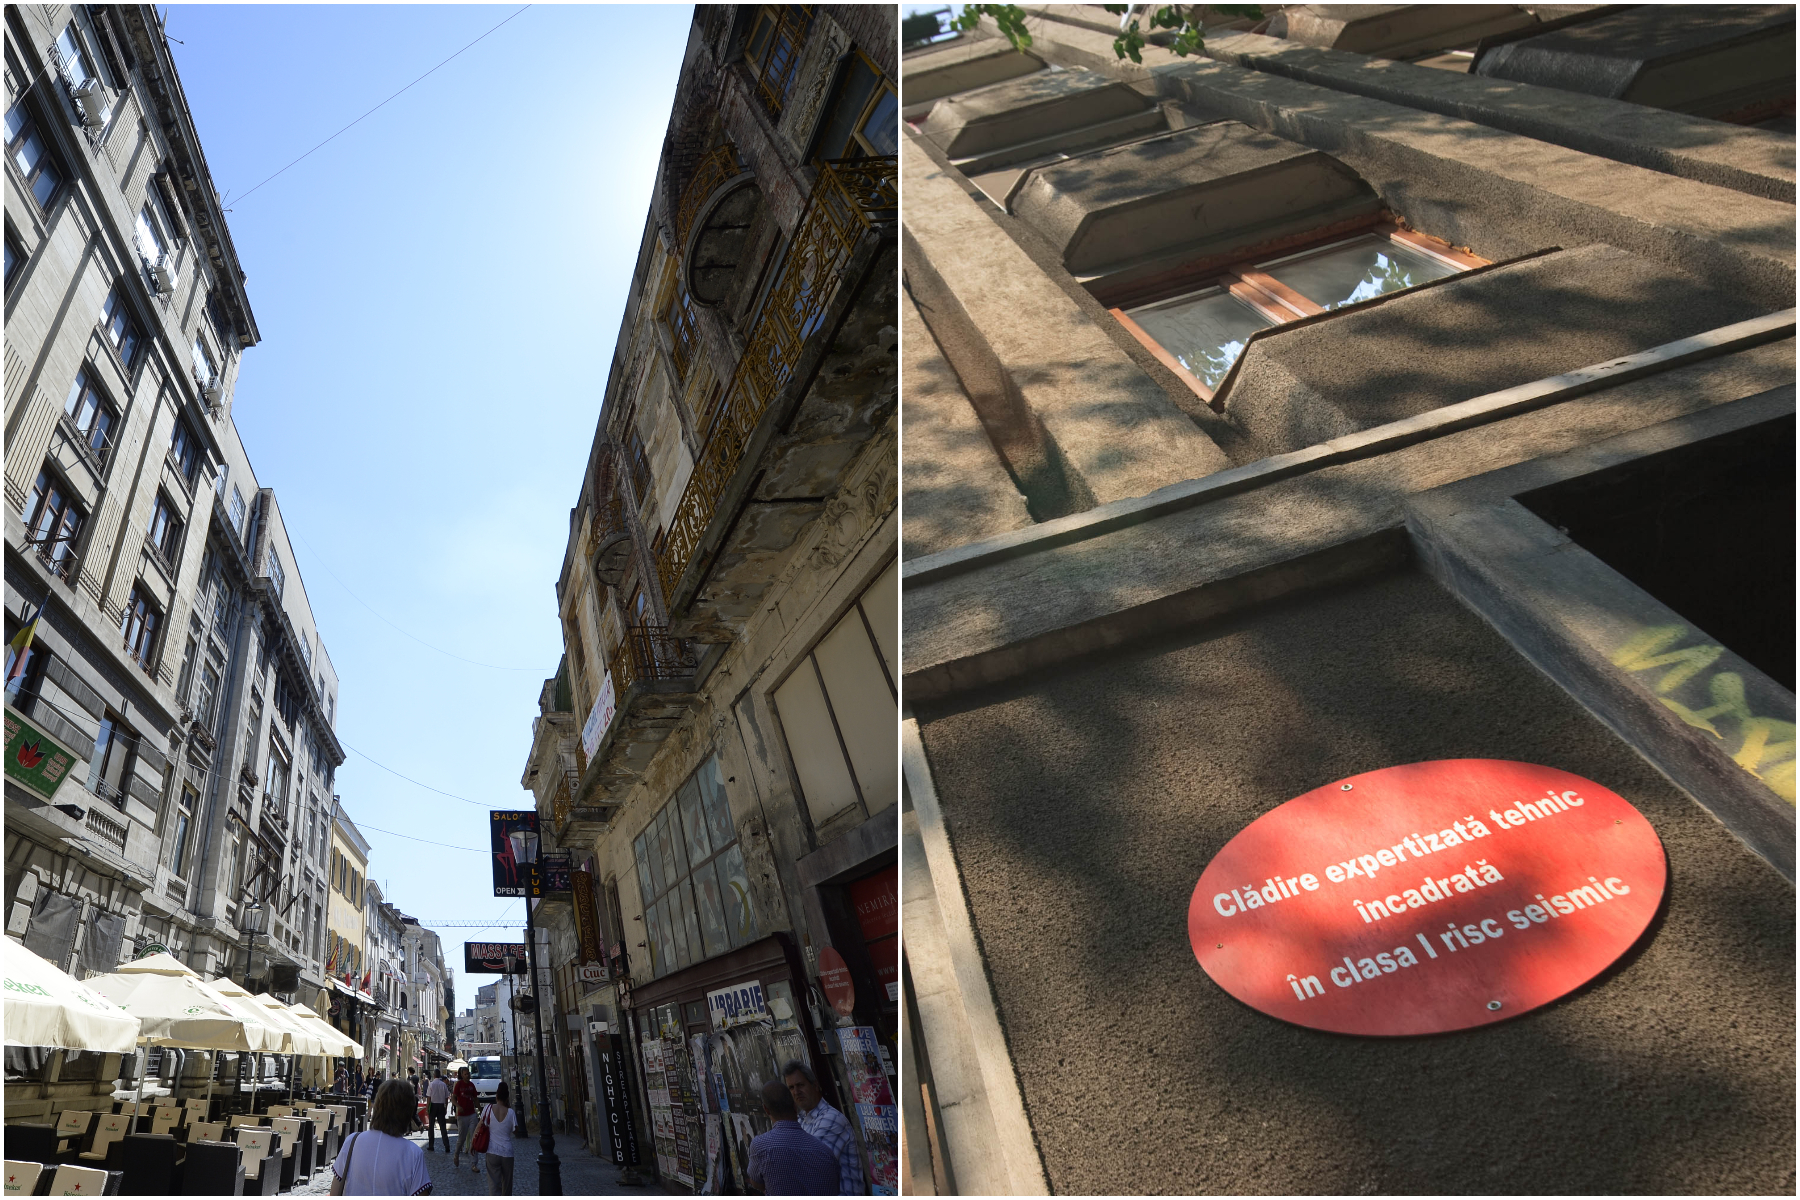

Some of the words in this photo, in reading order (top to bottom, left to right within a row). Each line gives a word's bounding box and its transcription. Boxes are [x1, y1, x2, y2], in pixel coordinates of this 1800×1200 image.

[1212, 873, 1319, 918] Clădire
[1325, 814, 1492, 883] expertizată
[1488, 787, 1585, 830] tehnic
[496, 887, 516, 895] OPEN
[857, 892, 897, 916] NEMIRA
[1353, 859, 1505, 923] încadrată
[1286, 973, 1325, 1001] în
[1330, 944, 1418, 988] clasa
[1415, 934, 1438, 959] I
[1440, 917, 1504, 956] risc
[1508, 874, 1631, 931] seismic
[583, 968, 606, 979] Ciuc
[602, 1052, 615, 1108] NIGHT
[611, 1112, 624, 1162] CLUB
